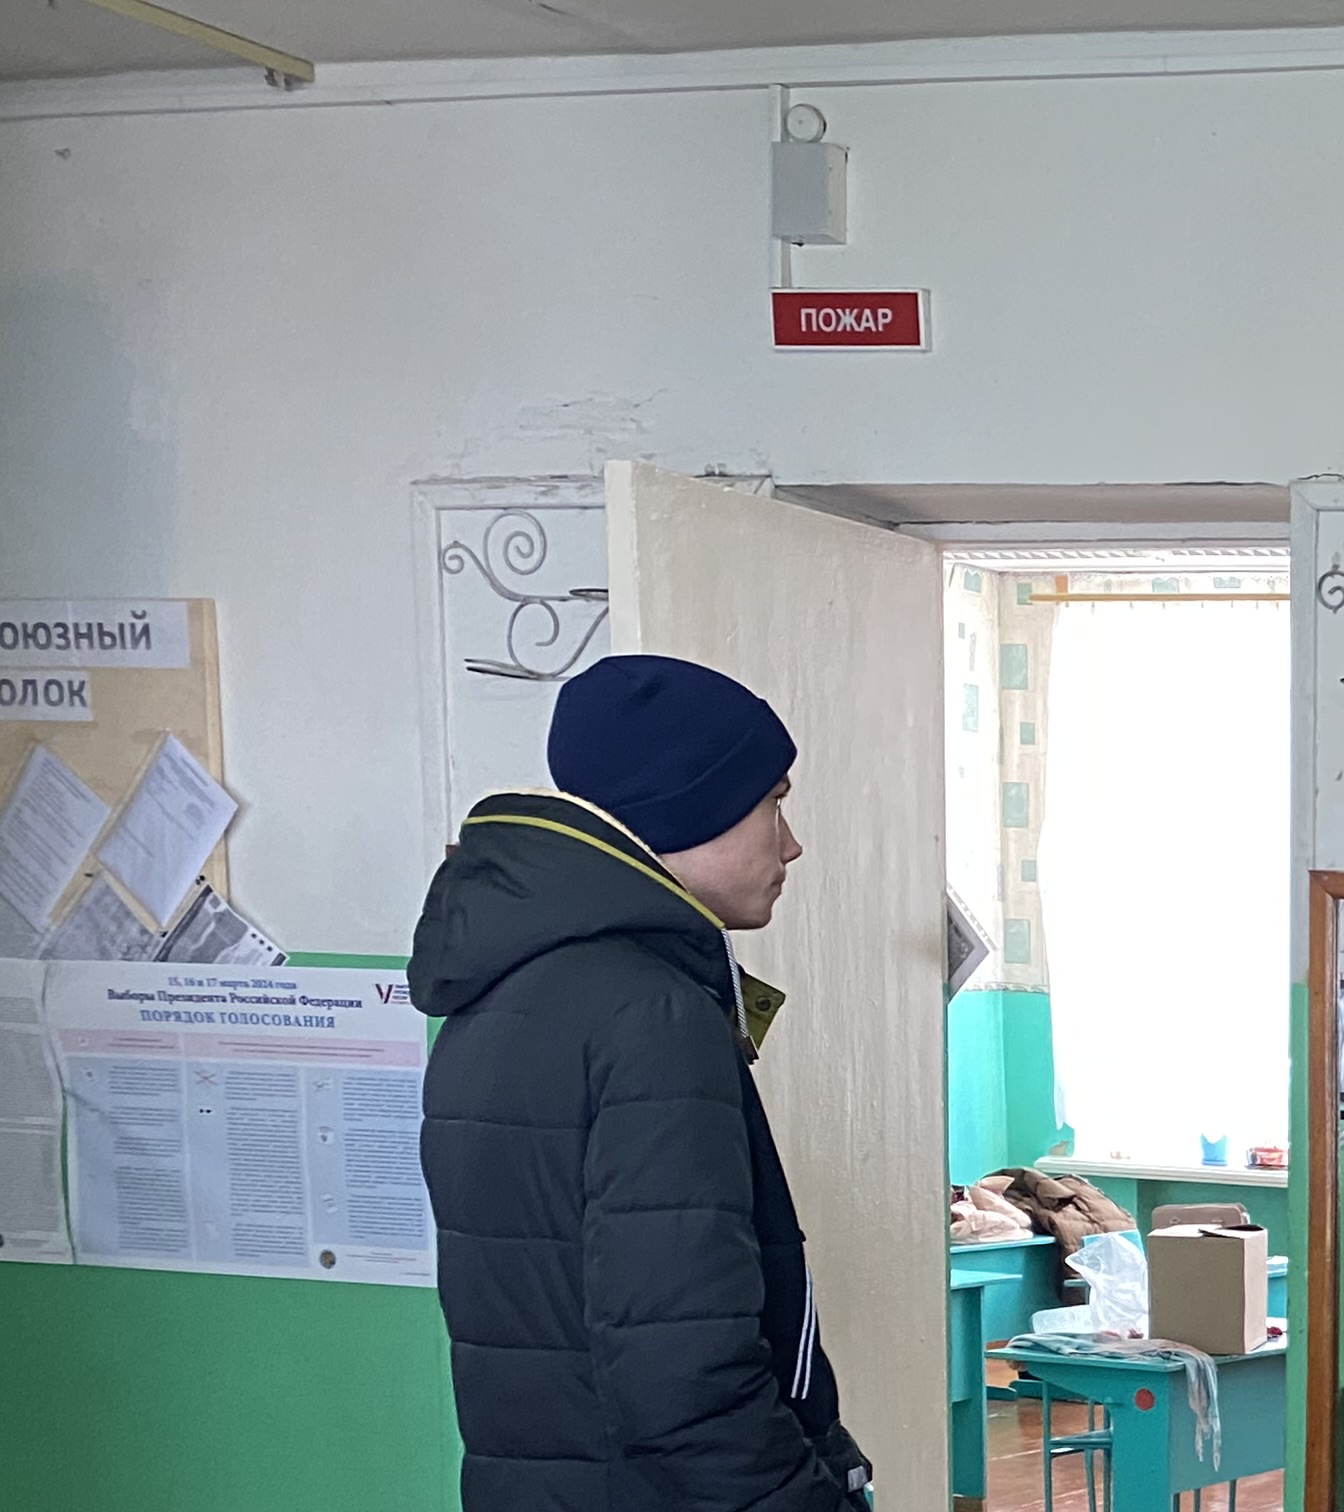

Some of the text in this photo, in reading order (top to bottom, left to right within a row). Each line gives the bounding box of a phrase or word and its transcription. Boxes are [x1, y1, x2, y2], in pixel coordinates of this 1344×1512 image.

[800, 308, 893, 332] ПОЖАР
[0, 609, 152, 650] ОЮЗНЫЙ
[0, 678, 88, 708] ОЛОК
[107, 989, 363, 1010] Выборы Президента Российской Федерации
[140, 1009, 336, 1029] ПОРЯДОК ГОЛОСОВАНИЯ
